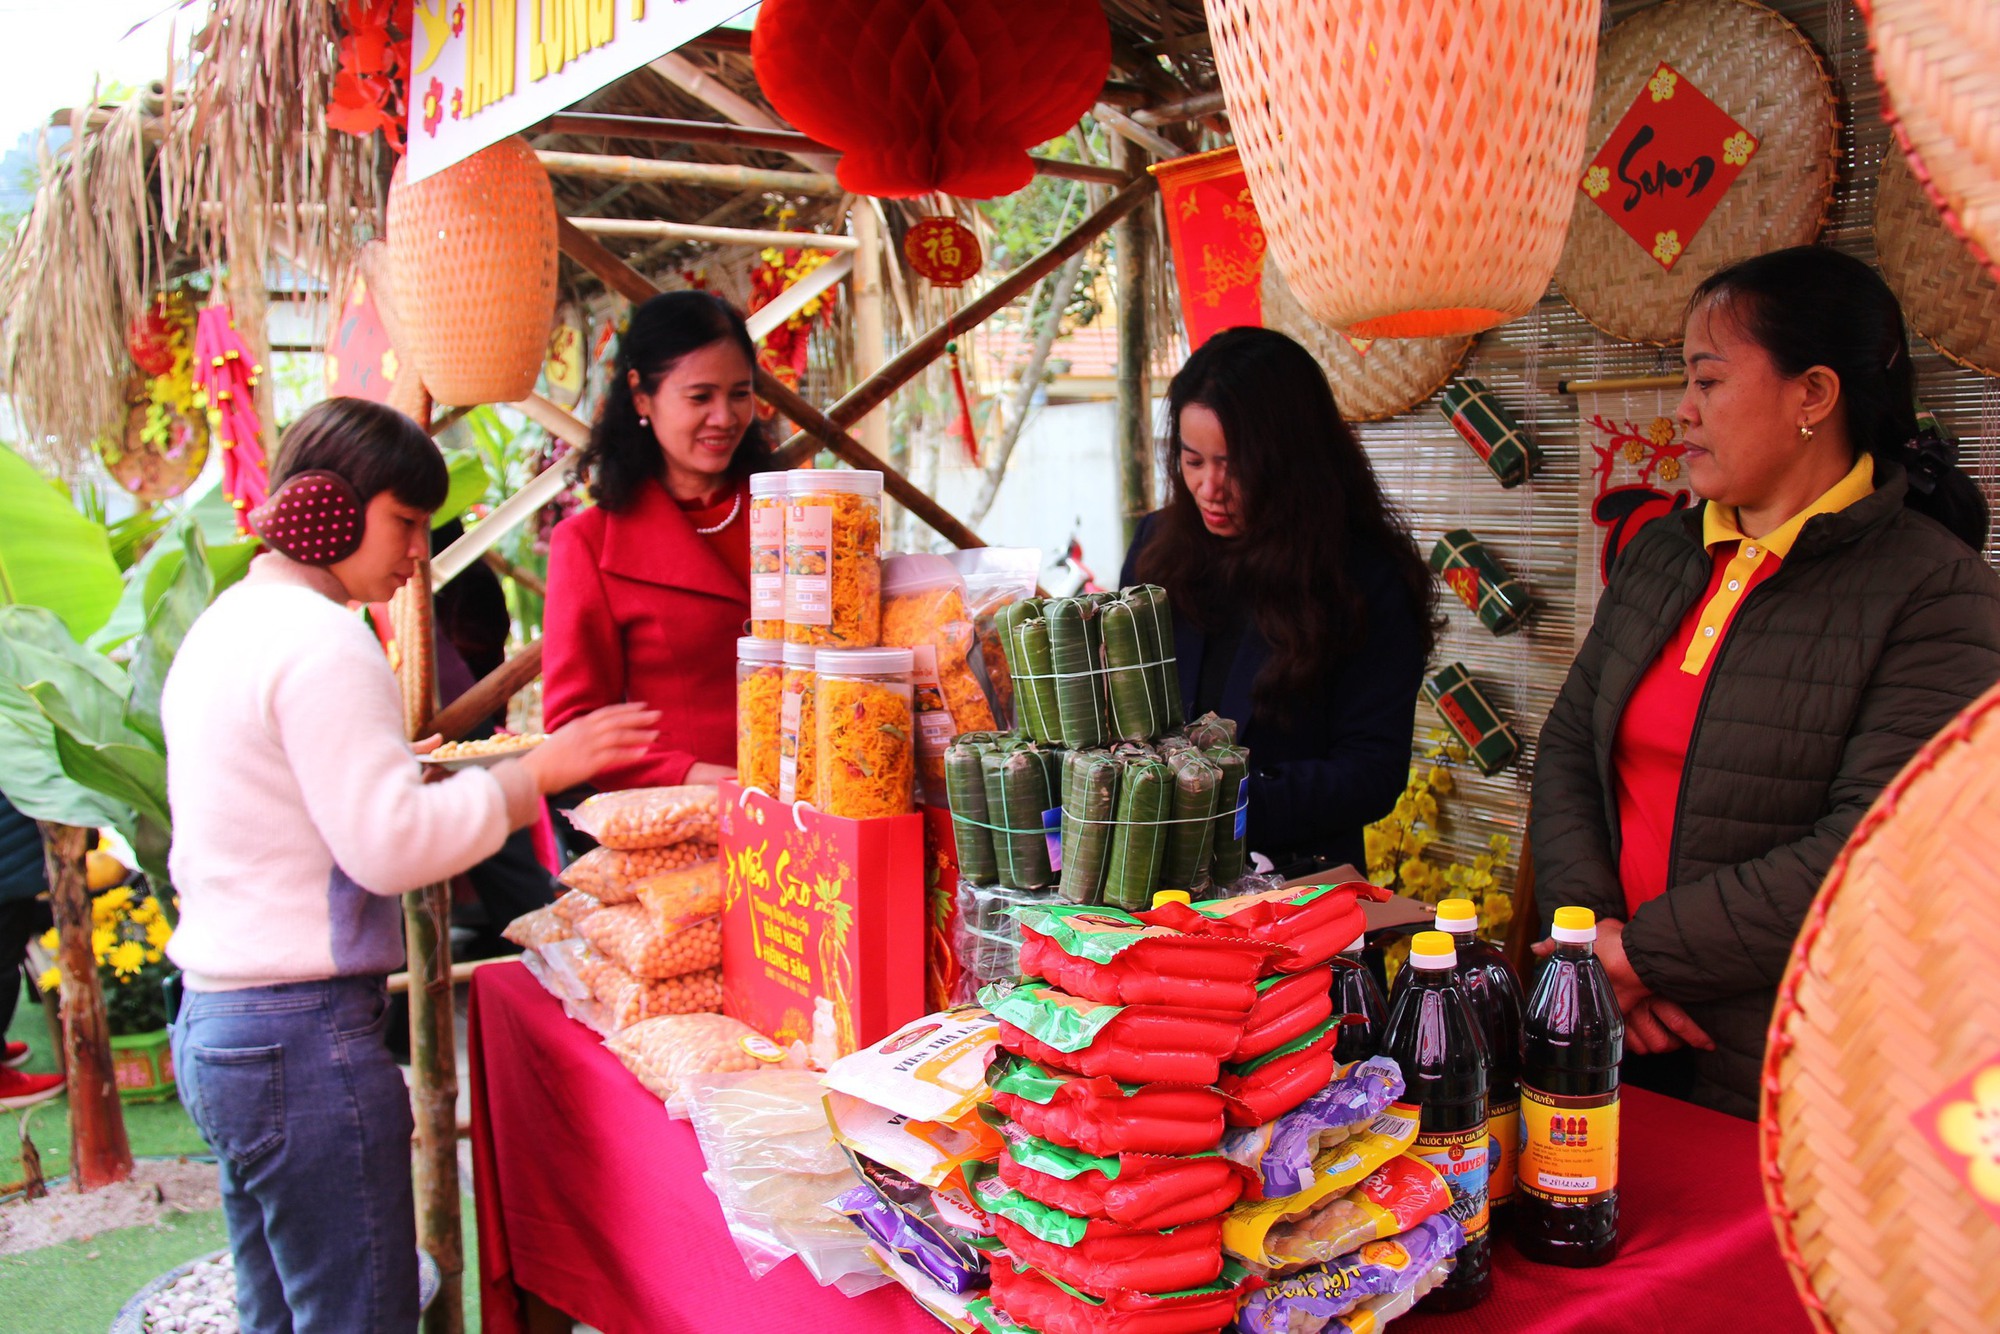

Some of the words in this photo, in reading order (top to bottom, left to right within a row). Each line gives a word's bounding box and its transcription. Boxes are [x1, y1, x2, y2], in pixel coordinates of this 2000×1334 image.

[921, 227, 960, 267] 福
[1419, 1135, 1442, 1146] NƯỚC
[1443, 1133, 1464, 1145] MẮM
[1464, 1131, 1476, 1142] GIA
